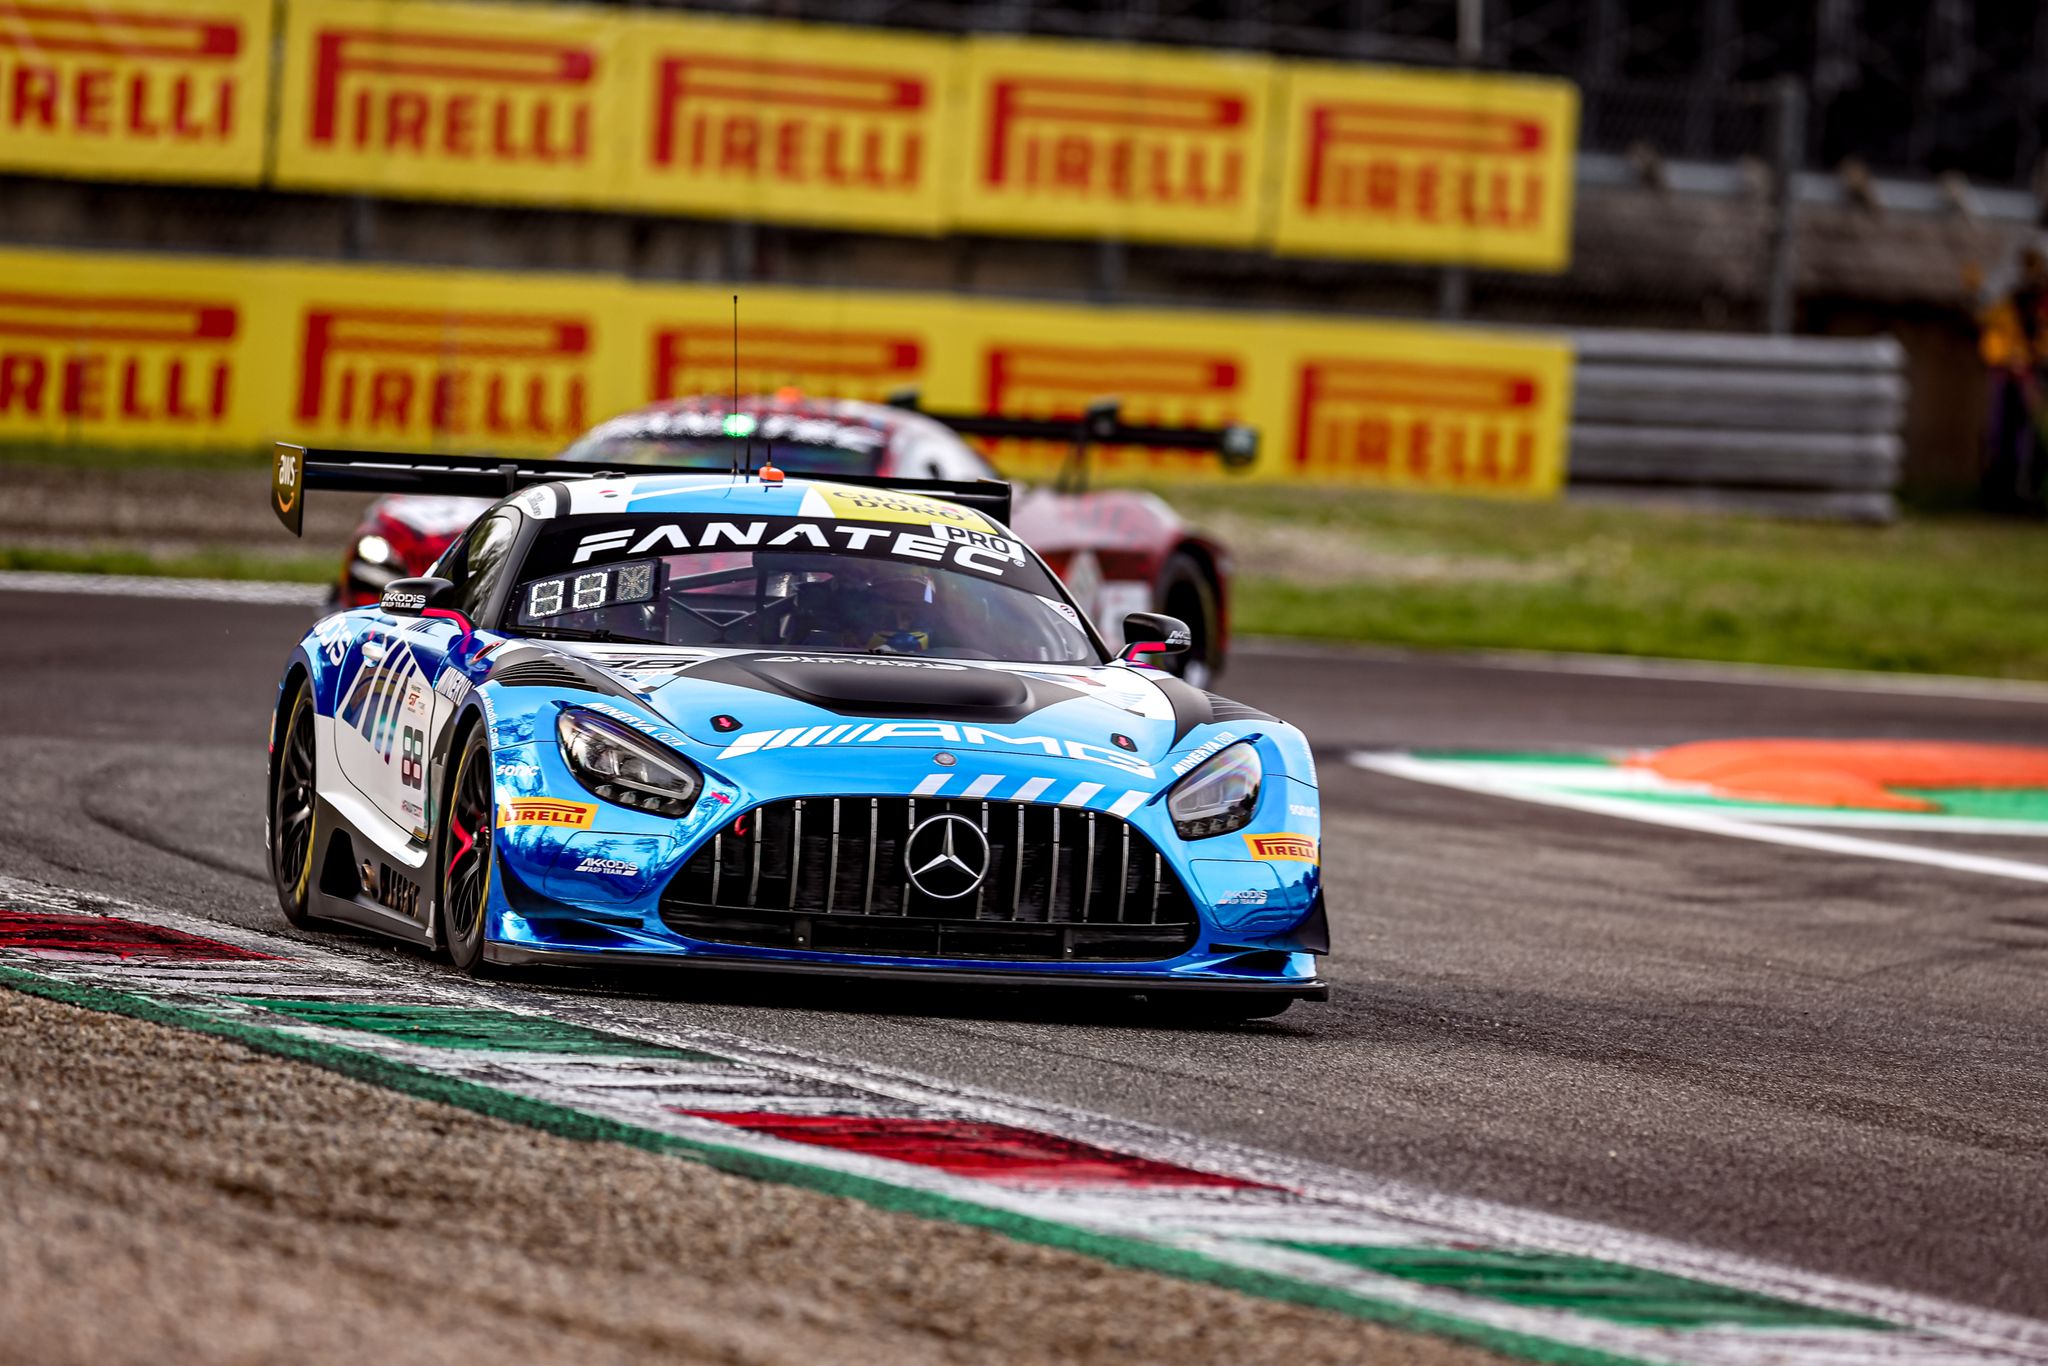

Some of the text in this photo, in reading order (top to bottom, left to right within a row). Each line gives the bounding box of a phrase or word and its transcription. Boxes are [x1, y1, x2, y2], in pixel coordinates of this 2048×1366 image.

[308, 28, 597, 163] PIRELLI
[650, 55, 925, 189] PIRELLI
[981, 76, 1248, 206] PIRELLI
[1302, 102, 1547, 231] PIRELLI
[297, 305, 591, 437] PIRELLI
[1293, 360, 1539, 487] PIRELLI
[279, 454, 296, 487] aws
[572, 522, 1010, 576] FANATEC
[946, 526, 1009, 554] PRO
[582, 702, 660, 734] MINERVA
[401, 725, 424, 791] 88
[857, 723, 1157, 780] AMG
[1170, 741, 1225, 777] MINERVA
[1252, 837, 1316, 859] PIRELLI
